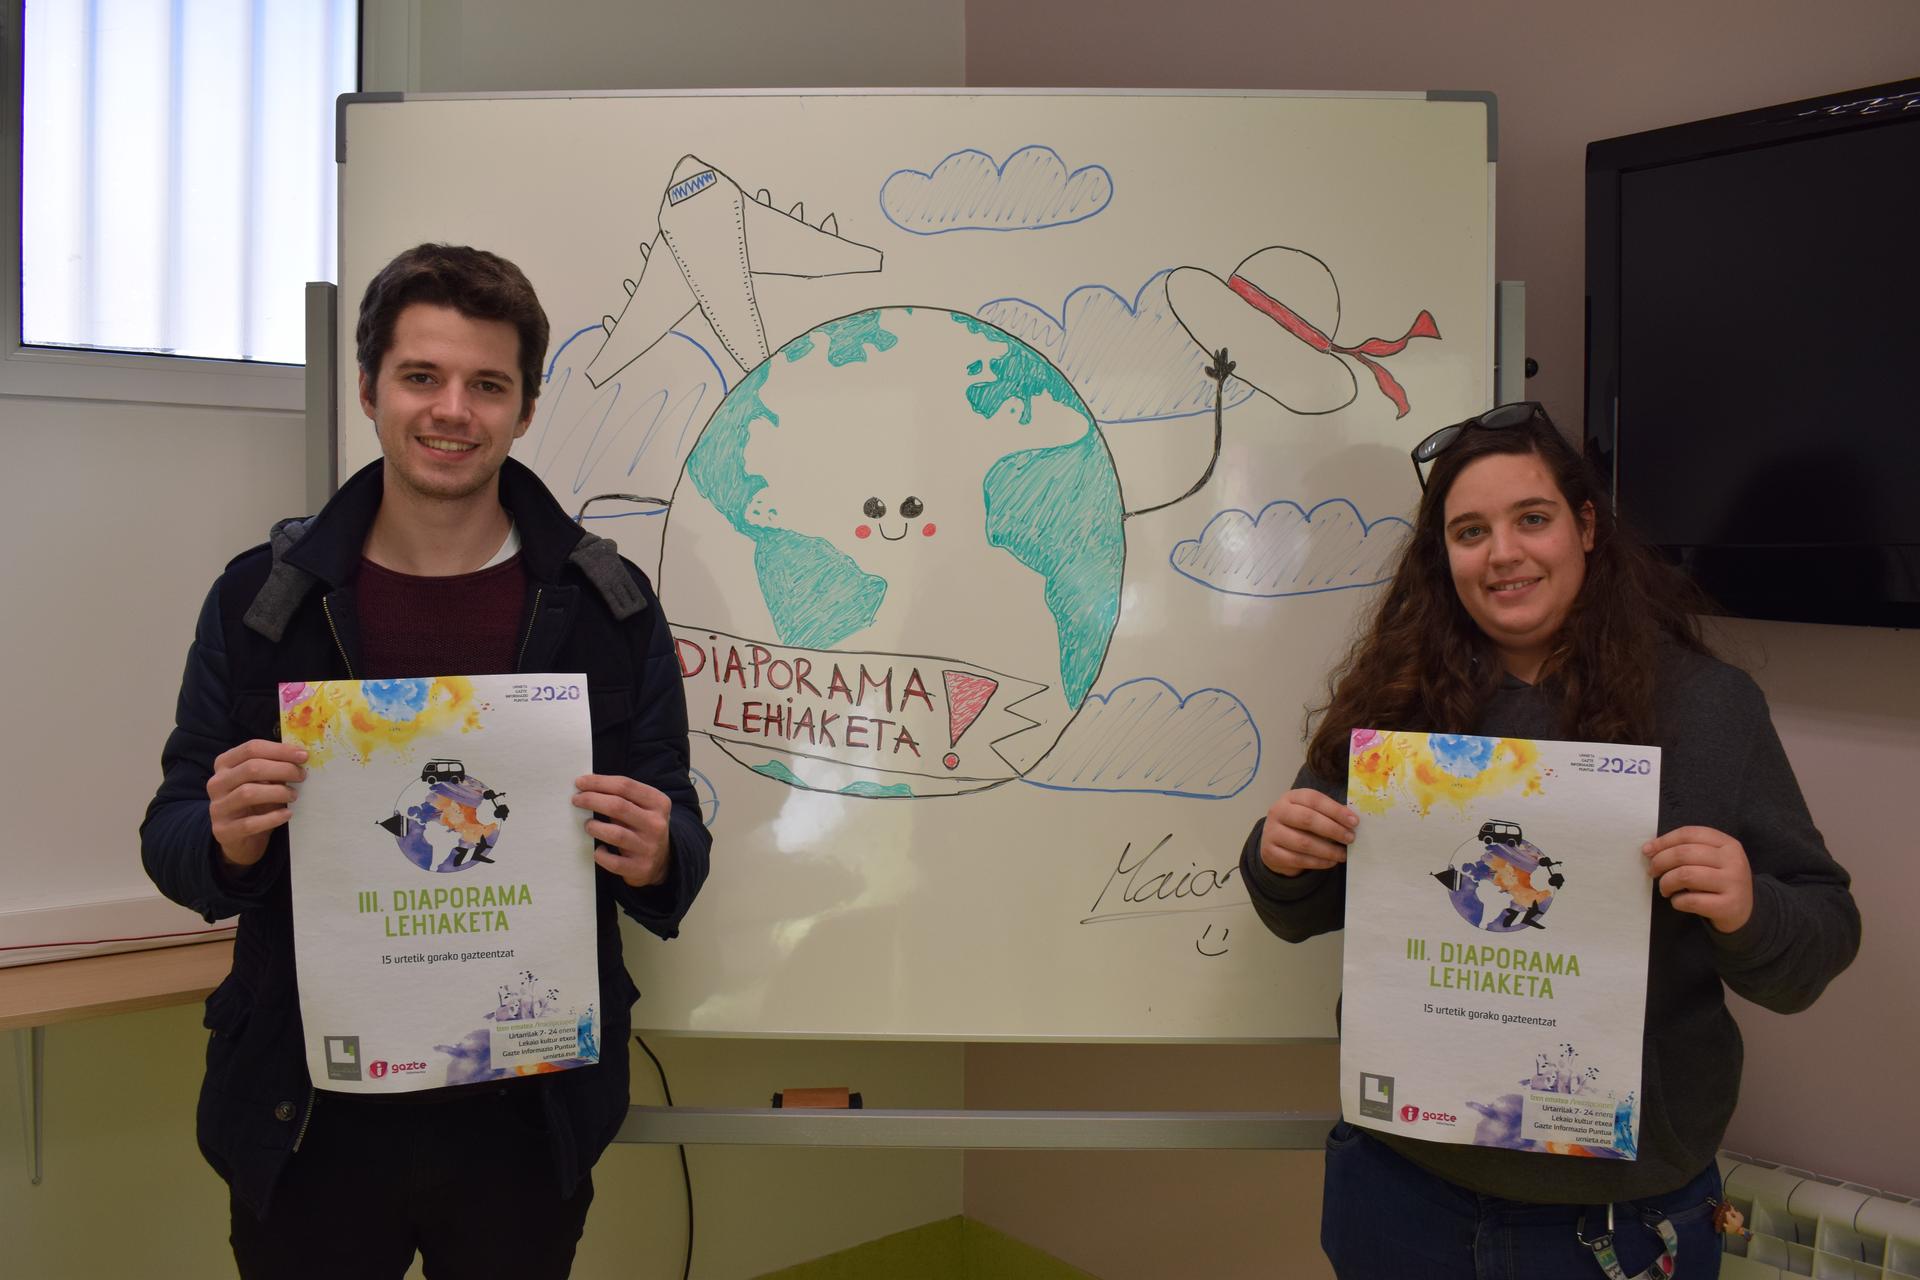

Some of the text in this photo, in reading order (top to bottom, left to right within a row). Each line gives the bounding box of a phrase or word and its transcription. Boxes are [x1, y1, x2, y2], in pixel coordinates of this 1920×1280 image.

[530, 685, 580, 702] 2020
[1597, 757, 1651, 775] 2020
[393, 883, 533, 912] DIAPORAMA
[385, 910, 510, 937] LEHIAKETA
[381, 949, 515, 965] 15 urtetik gorako gazteentzat
[1440, 941, 1581, 977] DIAPORAMA
[1429, 965, 1554, 1000] LEHIAKETA
[1423, 1003, 1557, 1027] 15 urtetik gorako gazteentzat
[502, 1049, 520, 1057] Gazte
[391, 1061, 427, 1074] gazte
[1422, 1111, 1457, 1123] gazte
[1542, 1104, 1573, 1114] Urtarrilak
[1583, 1109, 1594, 1117] 24
[1534, 1122, 1612, 1136] Gazte Informazio Puntua
[1574, 1117, 1593, 1125] kultur
